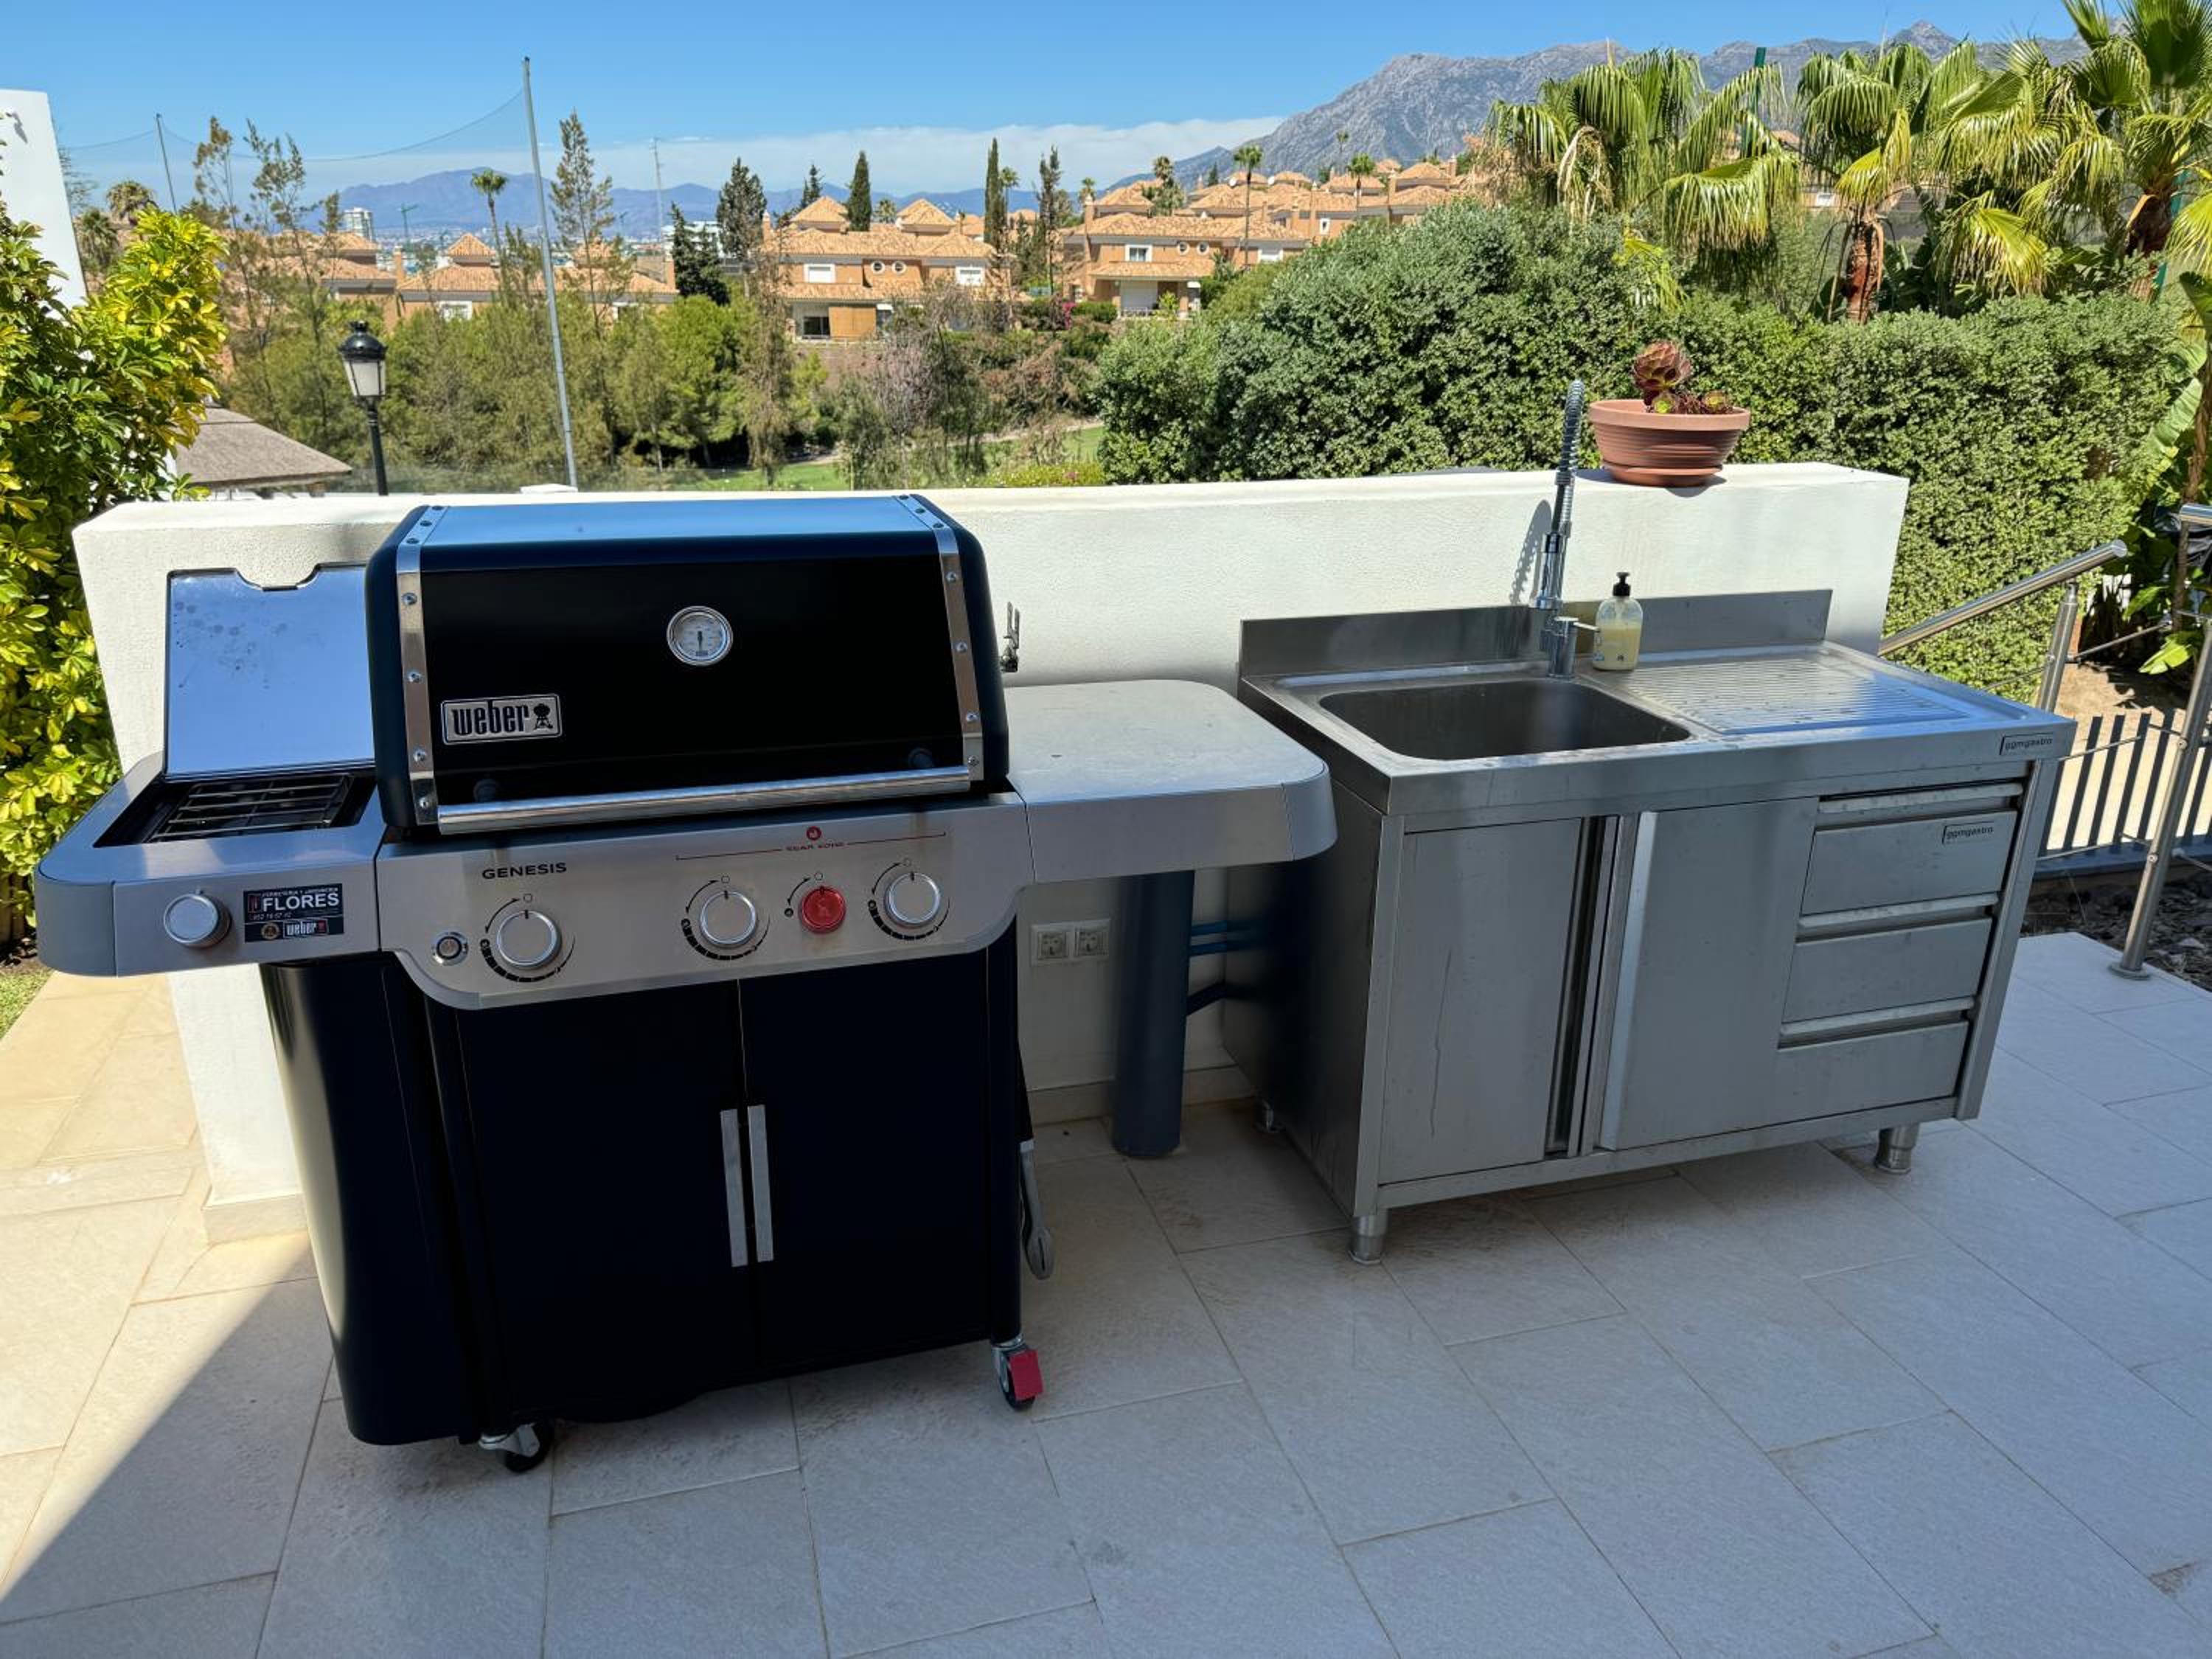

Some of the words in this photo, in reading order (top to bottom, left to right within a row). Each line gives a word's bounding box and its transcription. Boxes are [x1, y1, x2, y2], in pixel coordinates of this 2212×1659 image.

[451, 700, 529, 737] weber
[482, 862, 567, 880] GENESIS
[262, 893, 340, 912] FLORES
